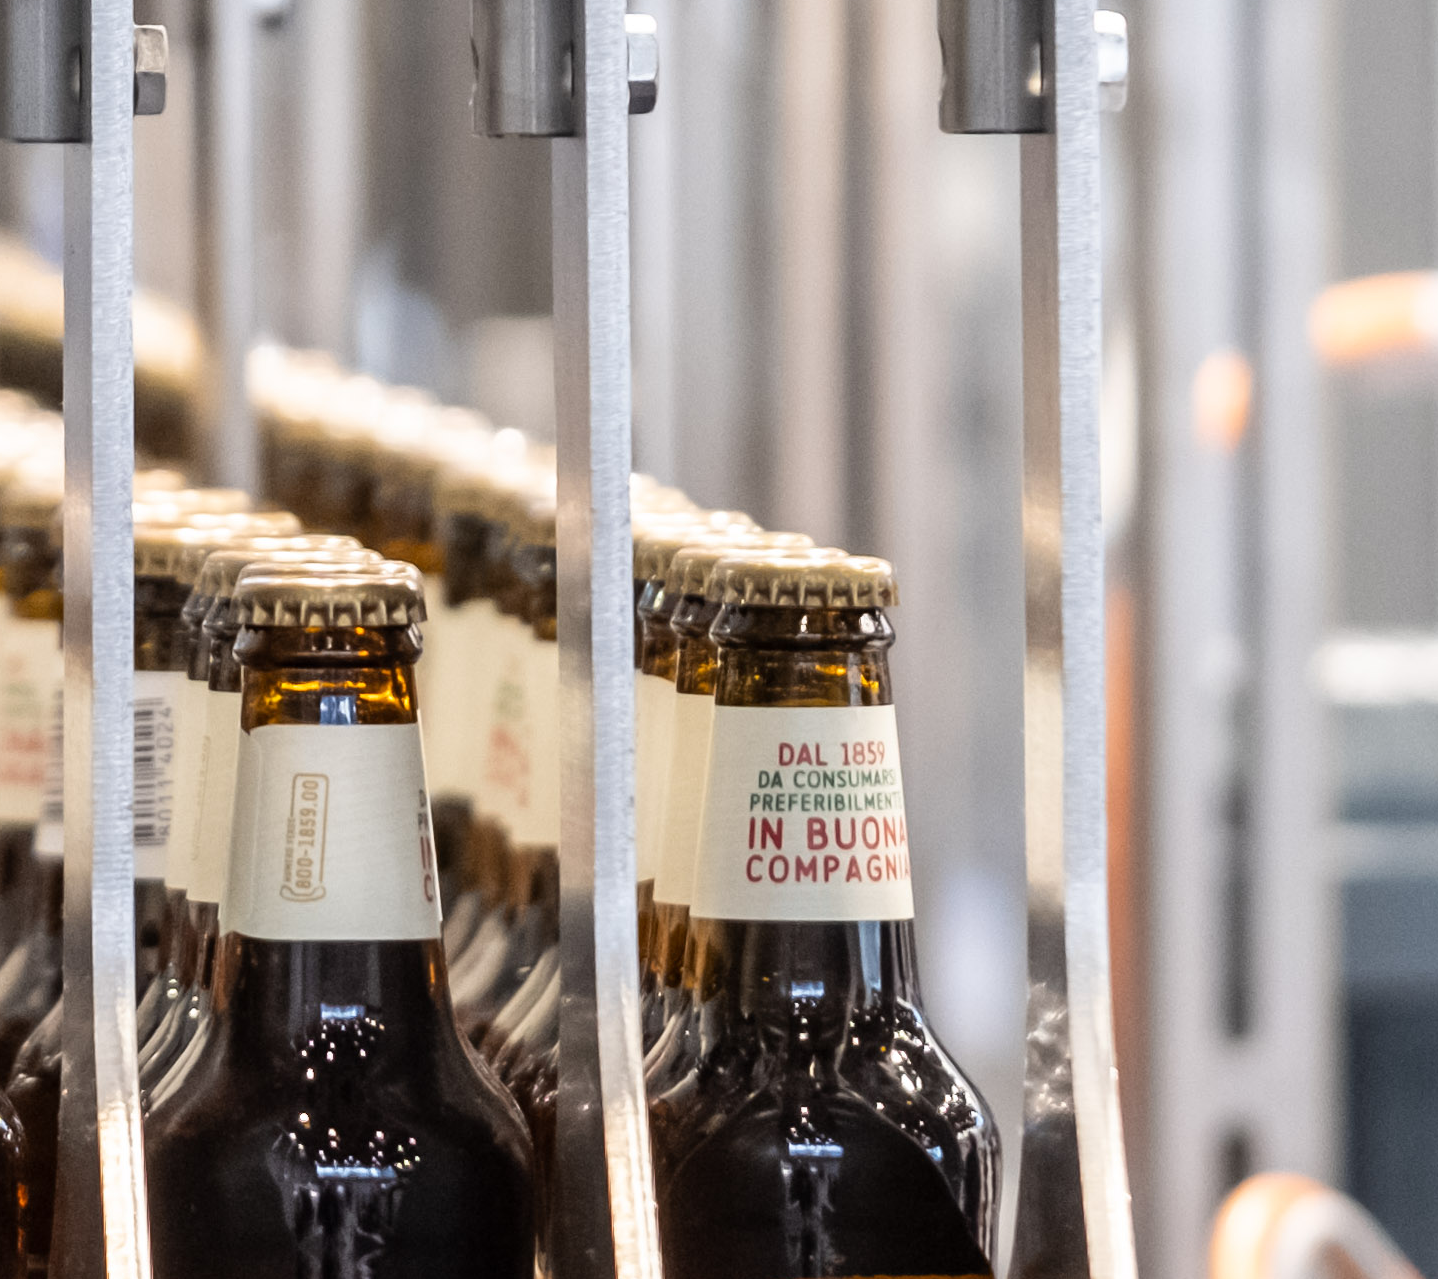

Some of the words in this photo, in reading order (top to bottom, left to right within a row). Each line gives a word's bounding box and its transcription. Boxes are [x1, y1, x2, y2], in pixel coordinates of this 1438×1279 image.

[777, 741, 828, 768] DAL
[841, 740, 886, 767] 1859
[757, 769, 784, 789] DA
[792, 768, 896, 789] CONSUMARS
[294, 779, 320, 890] 800-1859.00
[747, 816, 784, 851] IN
[806, 815, 908, 851] BUONA
[745, 853, 912, 884] COMPAGNIA
